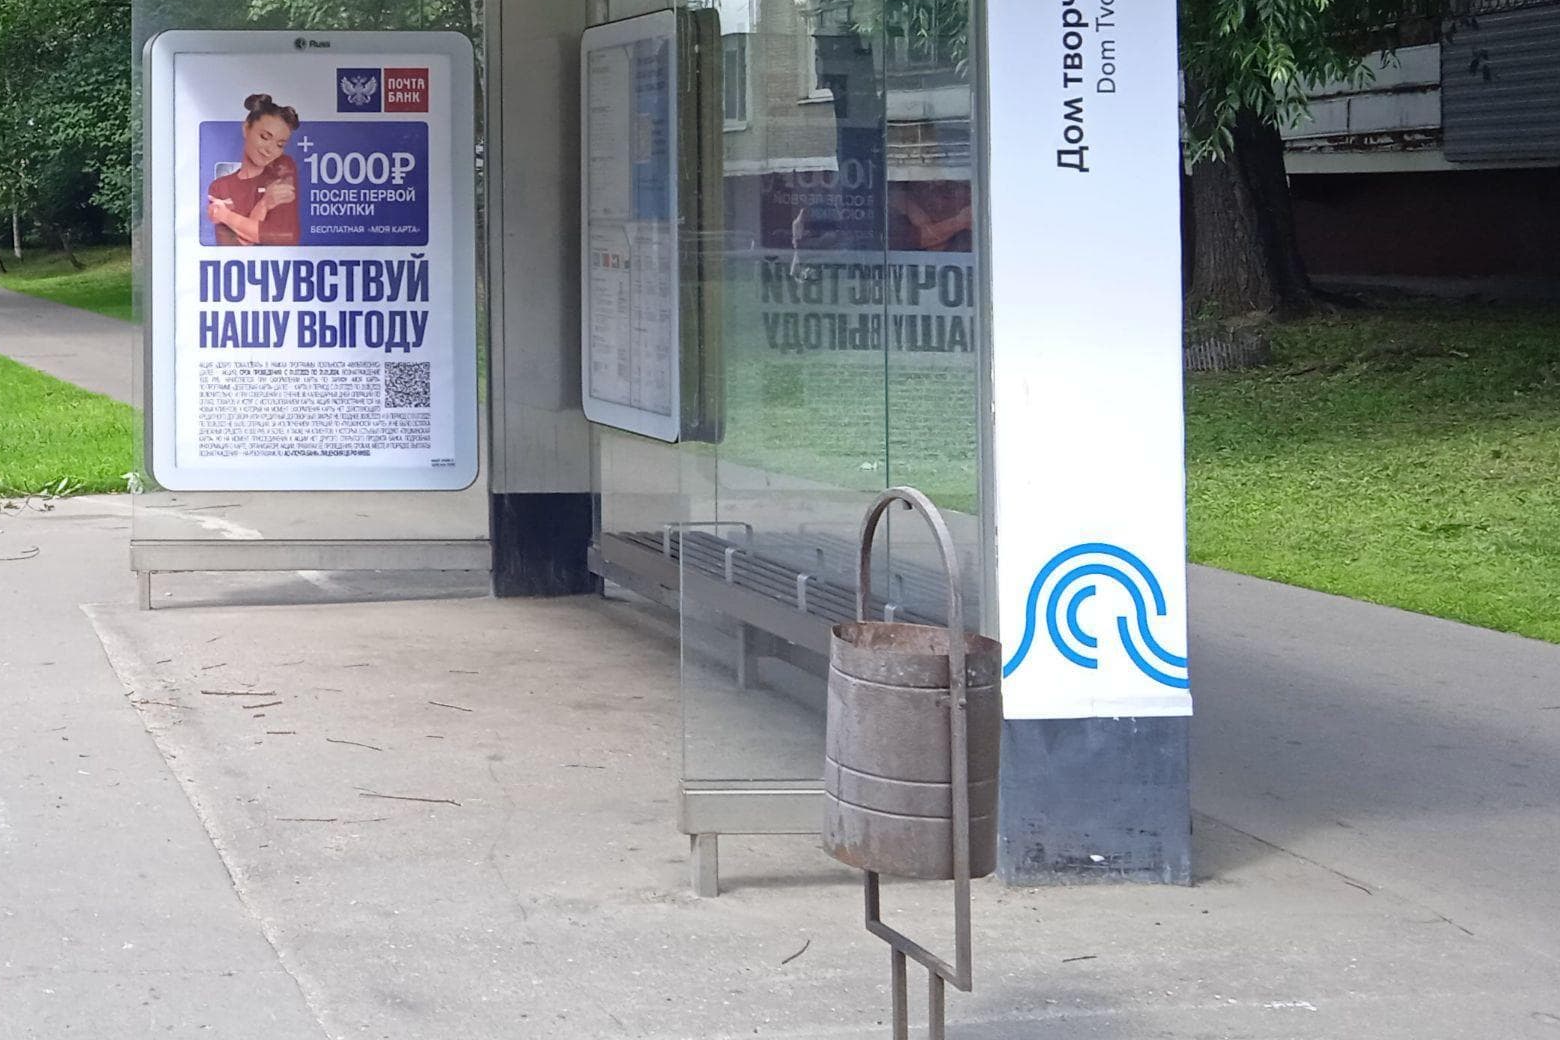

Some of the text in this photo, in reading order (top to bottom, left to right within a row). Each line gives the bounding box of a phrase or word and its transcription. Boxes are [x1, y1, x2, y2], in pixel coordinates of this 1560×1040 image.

[1096, 39, 1116, 94] Dom
[387, 78, 425, 90] ПОЧТА
[387, 91, 420, 103] БАНК
[1056, 96, 1090, 173] Дом
[310, 187, 416, 202] ПОСЛЕ ПЕРВОЙ
[310, 203, 375, 216] ПОКУПКИ
[310, 225, 365, 234] БЕСПЛАТНАЯ
[199, 252, 430, 303] ПОЧУВСТВУЙ
[199, 310, 430, 354] НАШУ ВЫГОДУ
